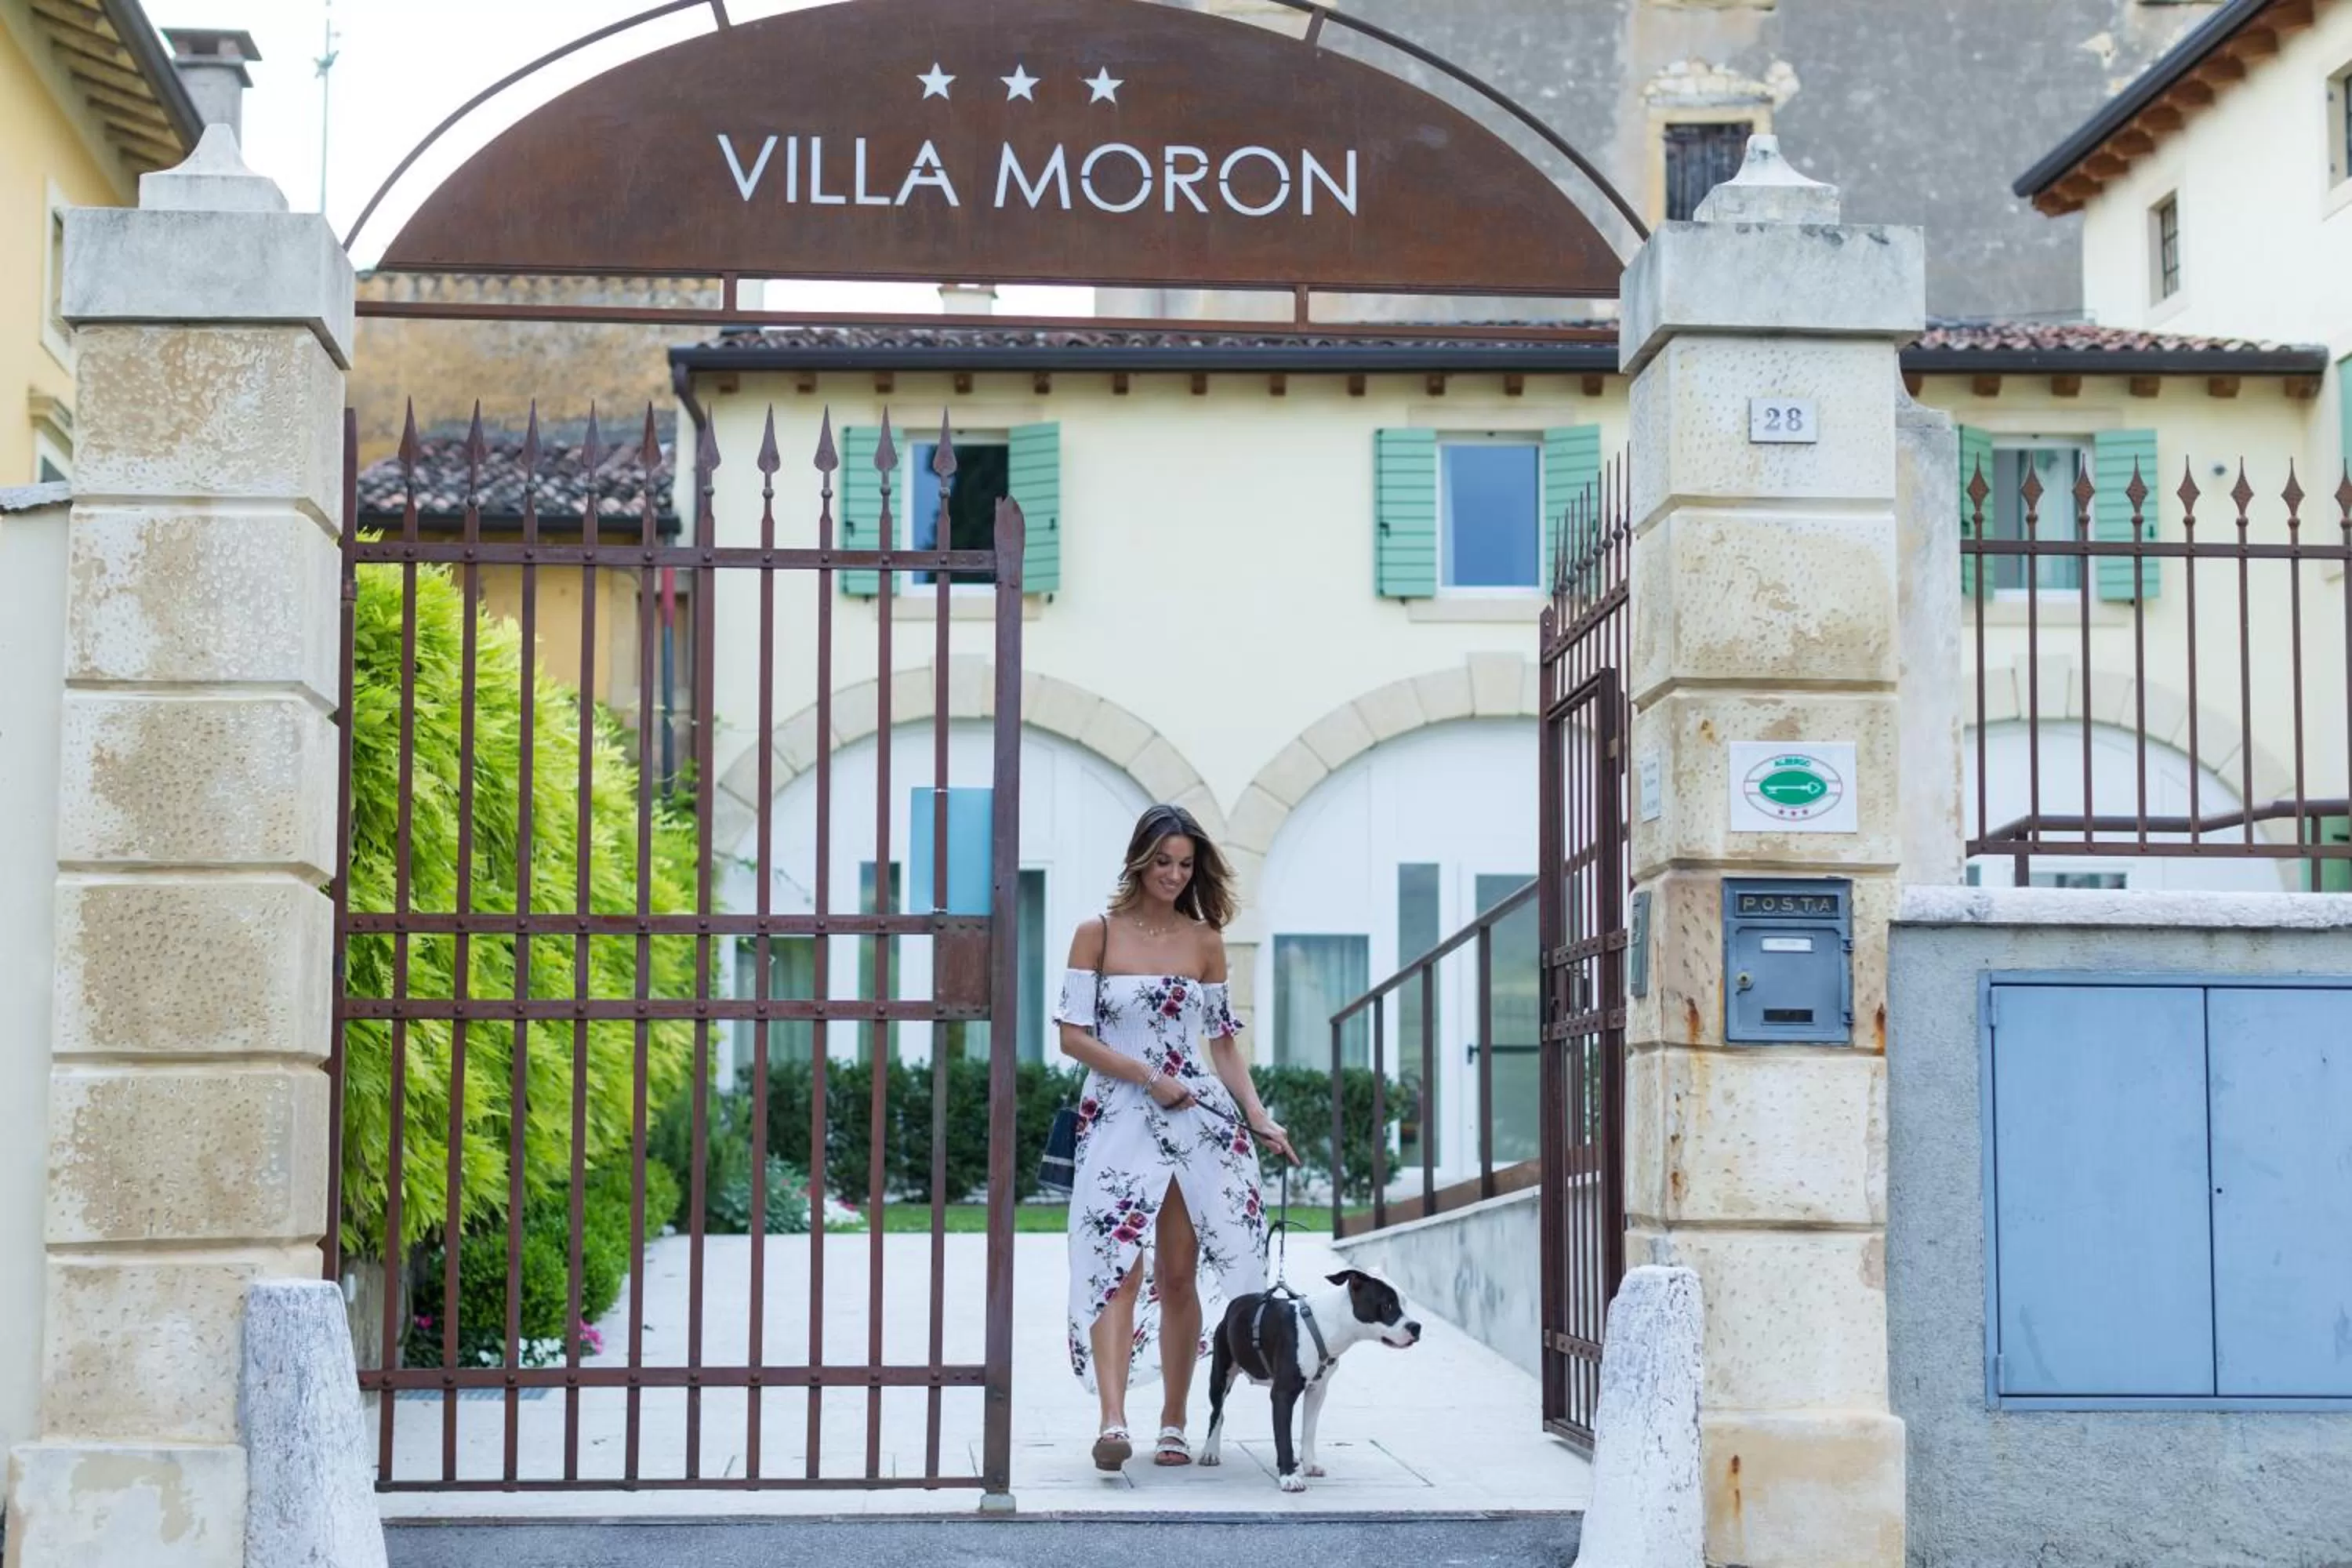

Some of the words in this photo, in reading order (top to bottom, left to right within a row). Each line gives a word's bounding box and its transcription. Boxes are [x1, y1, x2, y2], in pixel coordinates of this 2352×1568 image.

[717, 133, 960, 208] VILLA
[993, 140, 1358, 217] MORON
[1763, 407, 1803, 432] 28
[1743, 896, 1831, 912] POSTA
